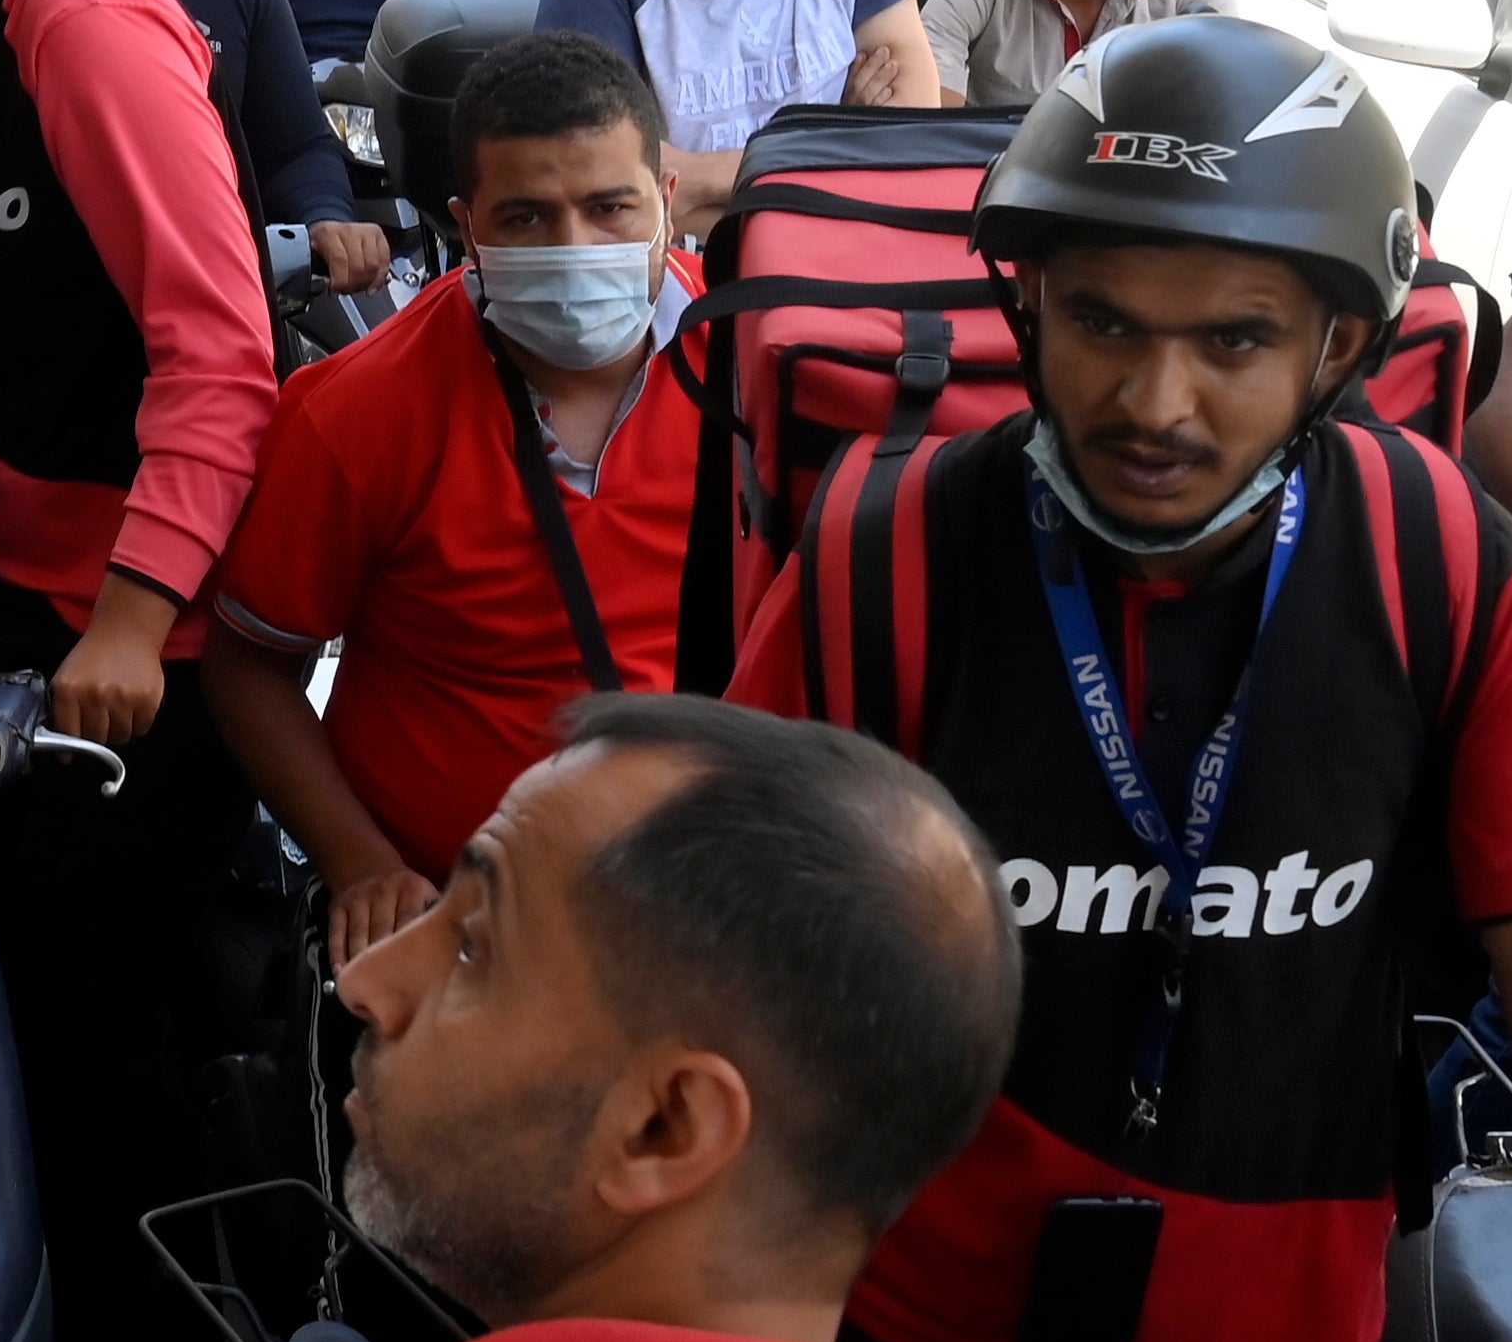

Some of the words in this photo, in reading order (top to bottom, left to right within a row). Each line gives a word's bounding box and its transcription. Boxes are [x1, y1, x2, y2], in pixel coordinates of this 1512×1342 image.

[675, 28, 849, 116] AMERICAN
[1071, 652, 1144, 800] NISSAN
[1183, 713, 1237, 859] NISSAN
[998, 848, 1375, 940] omato
